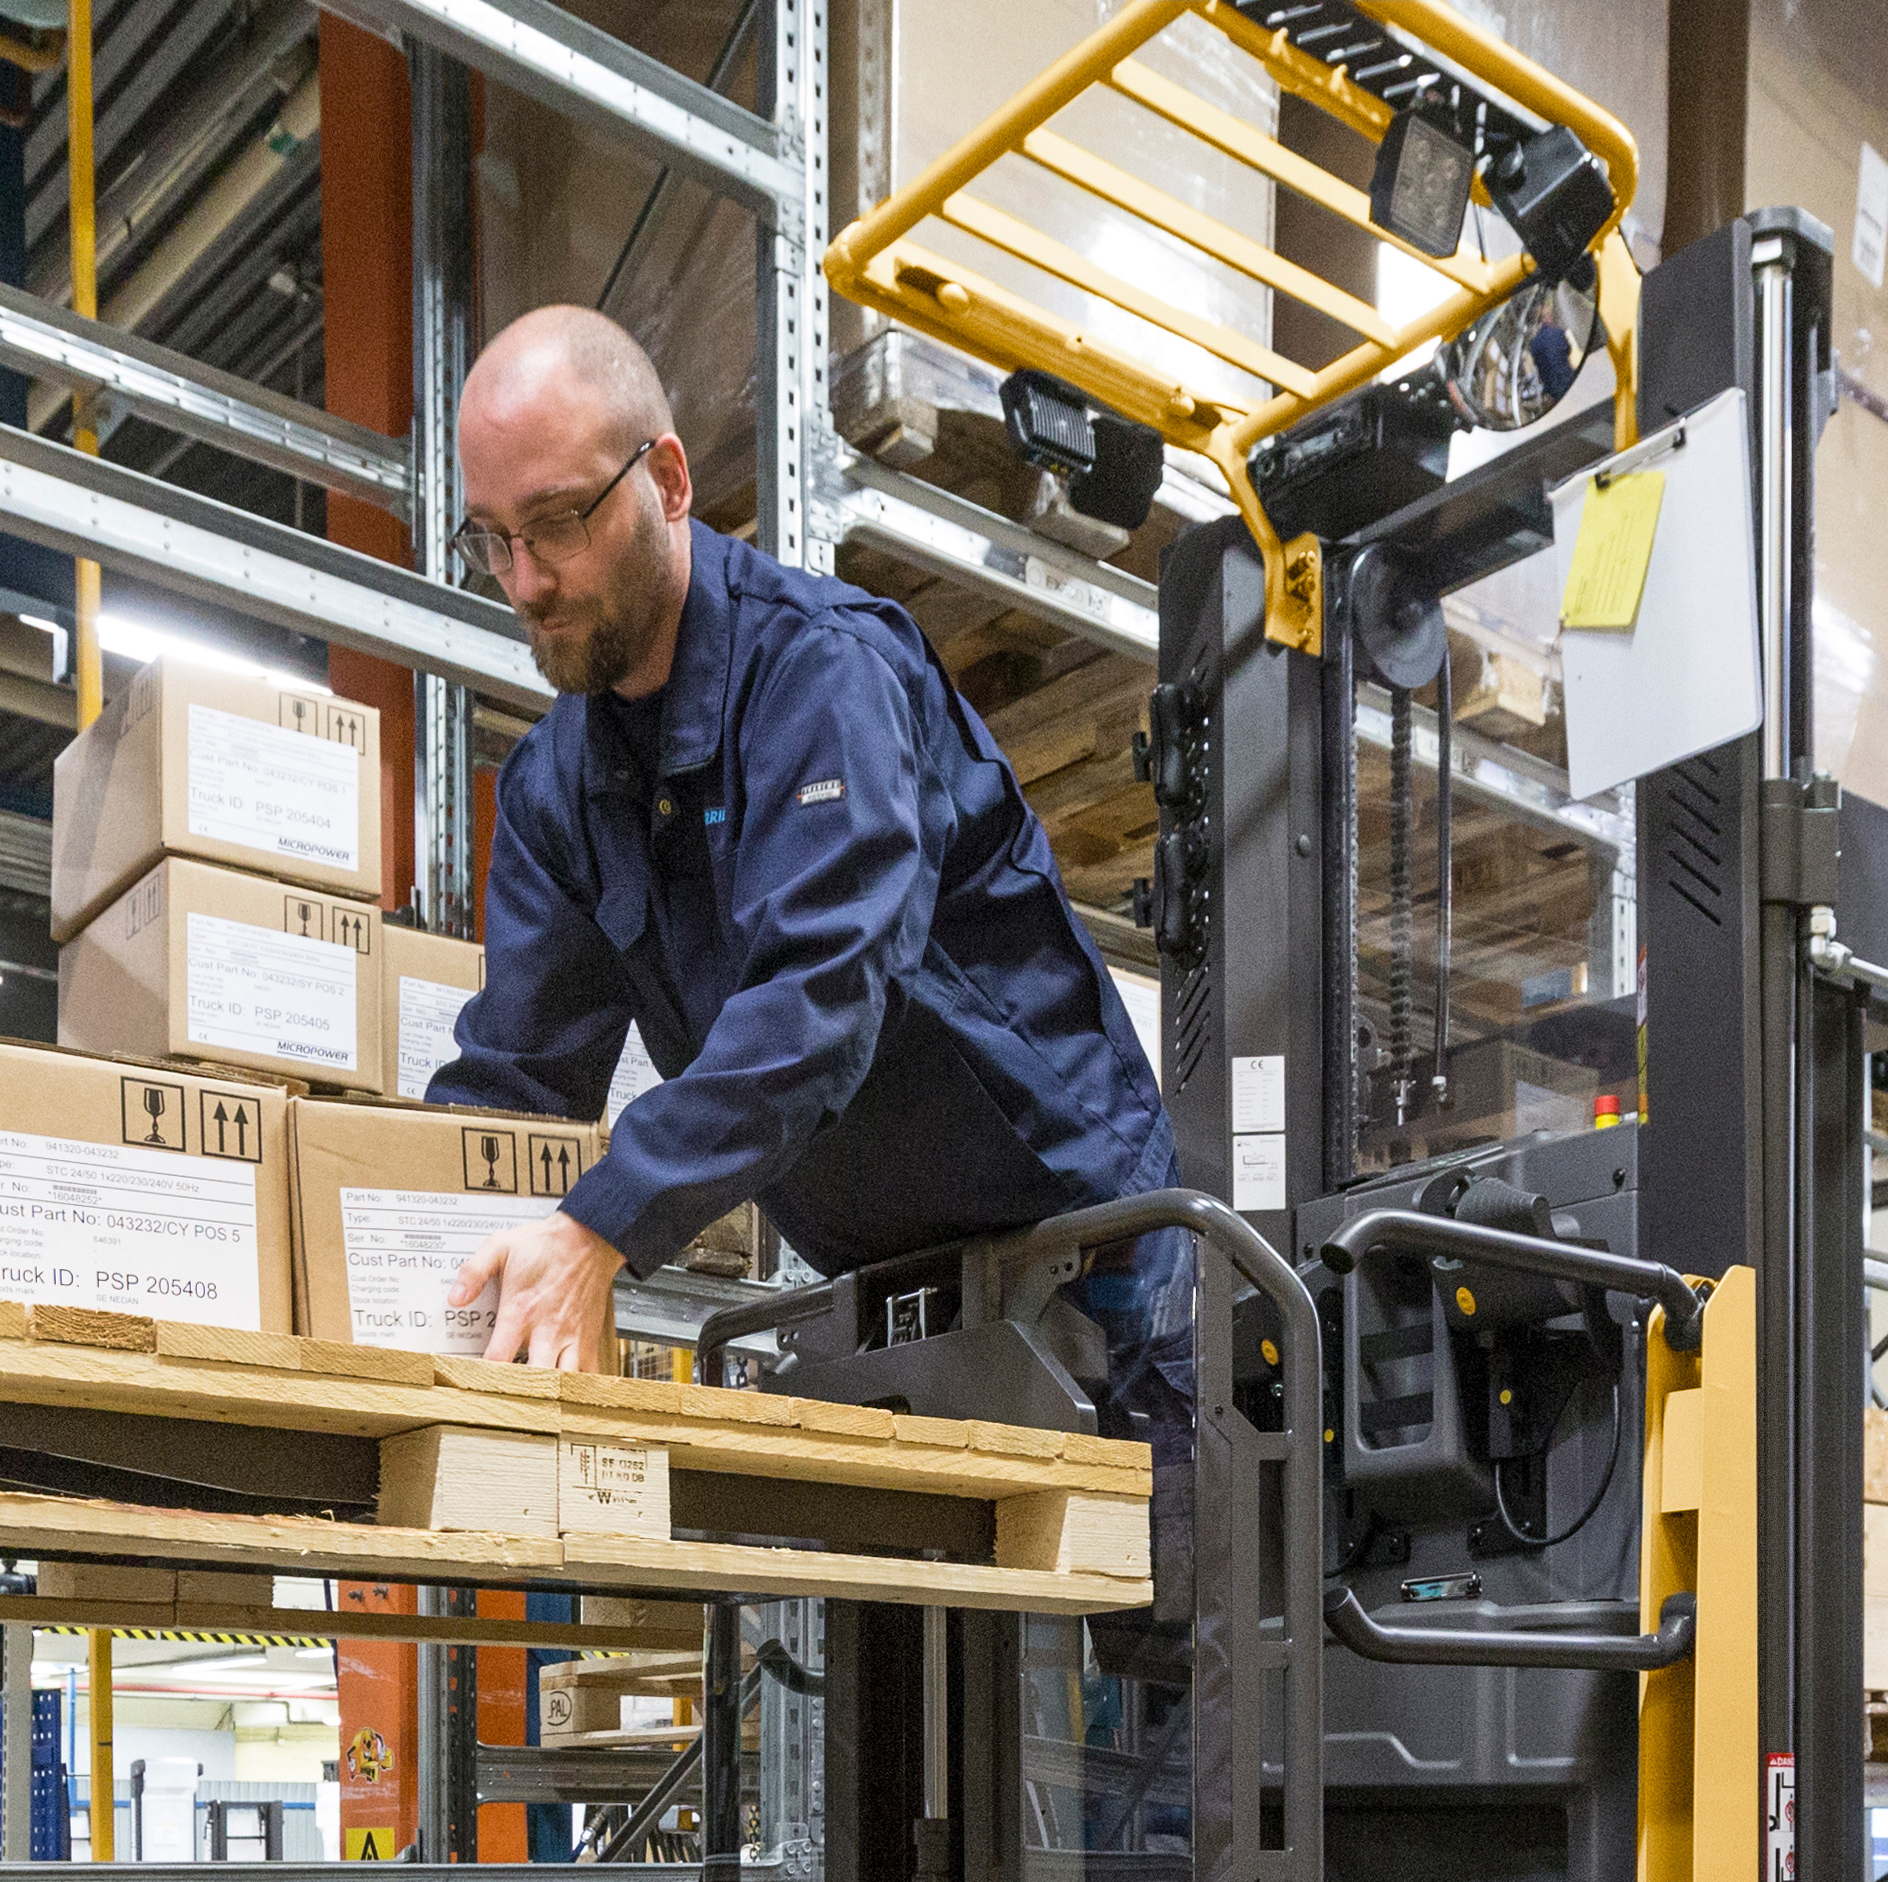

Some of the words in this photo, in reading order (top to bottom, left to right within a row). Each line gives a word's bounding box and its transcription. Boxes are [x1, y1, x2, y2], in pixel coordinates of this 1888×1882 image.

[217, 754, 239, 767] Part
[317, 780, 338, 793] POS
[191, 786, 225, 805] Truck
[255, 800, 283, 816] PSP
[286, 808, 331, 829] 205404
[188, 957, 214, 971] Cust
[217, 961, 239, 975] Part
[315, 982, 336, 996] POS
[338, 986, 344, 996] 2
[189, 995, 225, 1013] Truck
[255, 1006, 282, 1021] PSP
[286, 1012, 331, 1031] 205405
[400, 1016, 423, 1028] Cust
[426, 1022, 446, 1034] Part
[400, 1052, 431, 1069] Truck
[45, 1141, 119, 1159] 941320-043232
[12, 1182, 31, 1193] No:
[46, 1165, 68, 1177] STC
[71, 1168, 97, 1180] 24/50
[100, 1173, 173, 1190] 1x220/230/240V
[176, 1181, 200, 1193] 50Hz
[346, 1192, 365, 1202] Part
[31, 1204, 66, 1223] Part
[72, 1209, 101, 1227] No:
[106, 1214, 189, 1236] 043232/CY
[194, 1224, 227, 1242] POS
[232, 1229, 241, 1243] 5
[398, 1216, 416, 1226] STC
[6, 1225, 30, 1236] Order
[347, 1233, 364, 1243] Ser
[348, 1252, 383, 1267] Cust
[387, 1253, 418, 1268] Part
[422, 1255, 447, 1270] No:
[52, 1267, 81, 1288] ID:
[96, 1270, 139, 1291] PSP
[146, 1276, 218, 1301] 205408
[96, 1294, 107, 1303] SE
[353, 1309, 404, 1327] Truck
[408, 1310, 433, 1328] ID:
[444, 1310, 482, 1328] PSP
[548, 1699, 567, 1718] PAL
